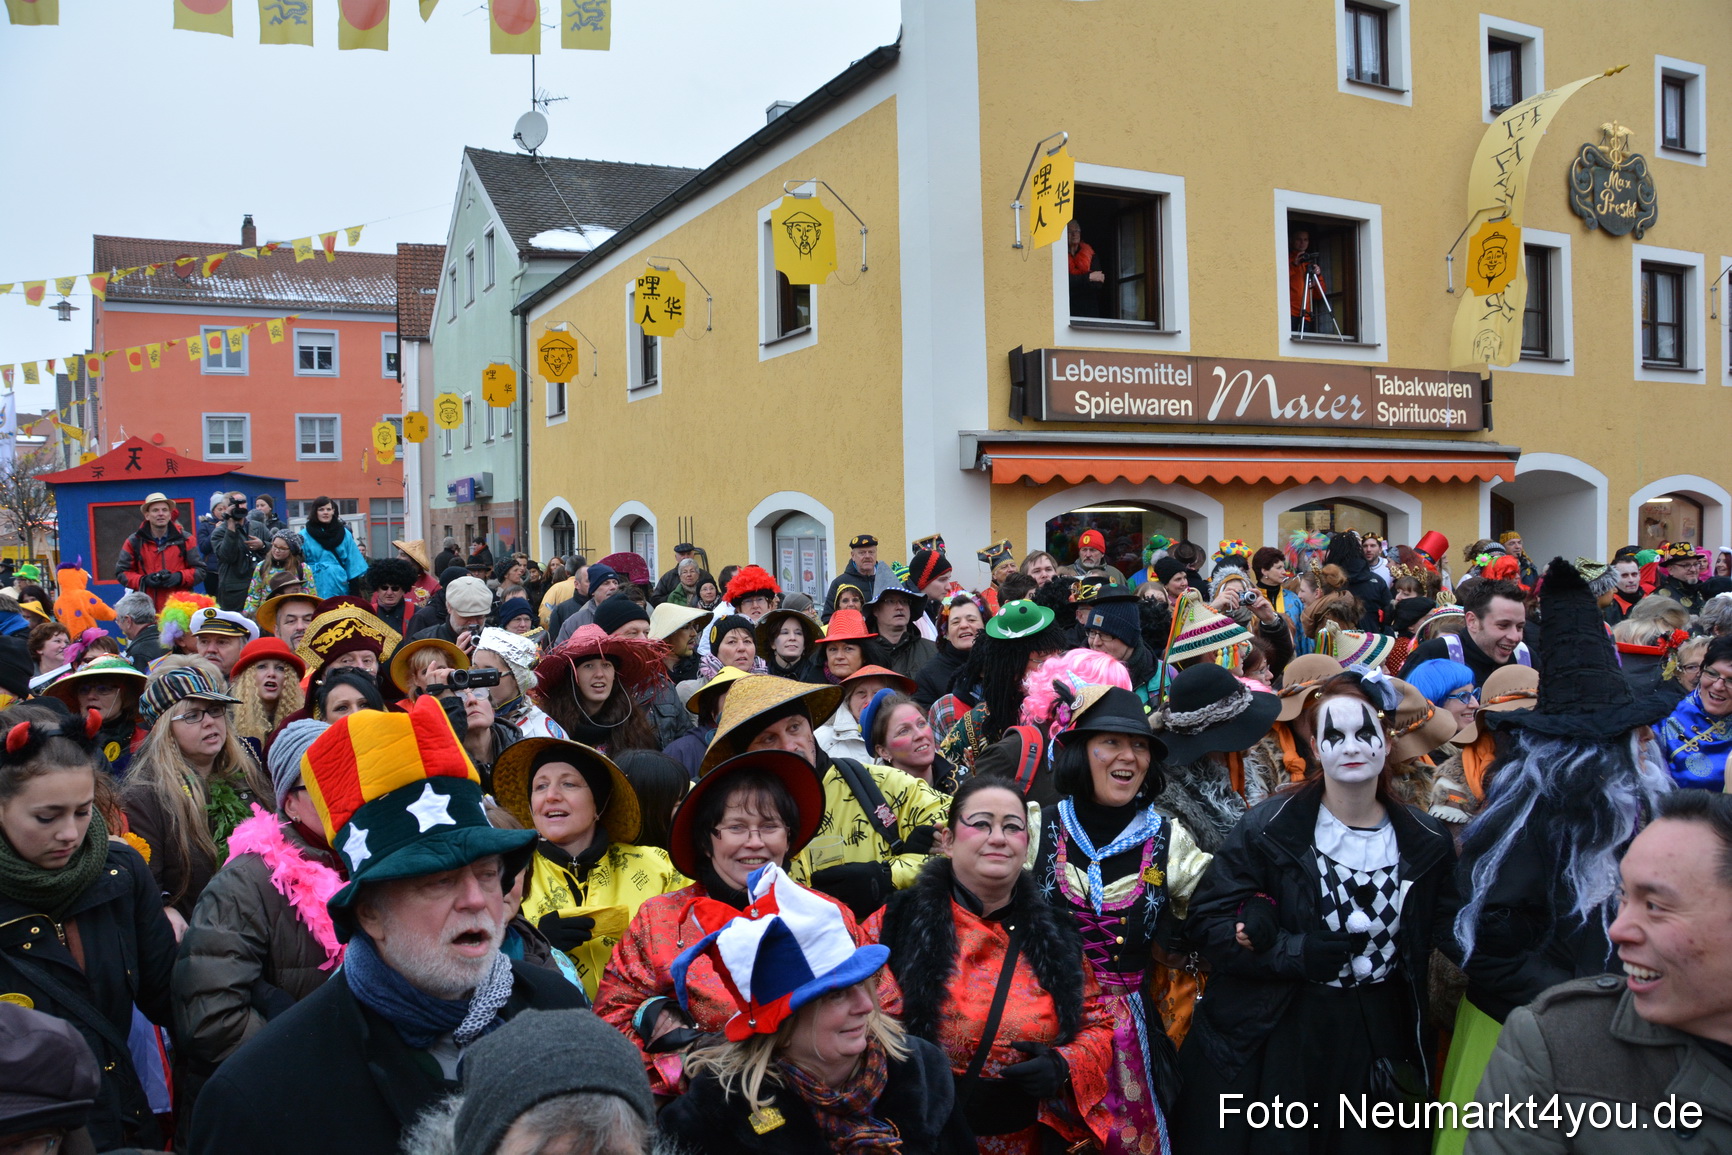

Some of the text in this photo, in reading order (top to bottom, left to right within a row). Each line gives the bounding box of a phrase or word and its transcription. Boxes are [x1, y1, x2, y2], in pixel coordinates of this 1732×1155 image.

[1603, 170, 1631, 192] Max
[1596, 189, 1637, 218] Prestel
[1051, 357, 1193, 387] Lebensmittel
[1375, 373, 1473, 400] Tabakwaren
[1073, 389, 1193, 418] Spielwaren
[1206, 365, 1367, 422] Maier
[1376, 400, 1467, 425] Spirituosen
